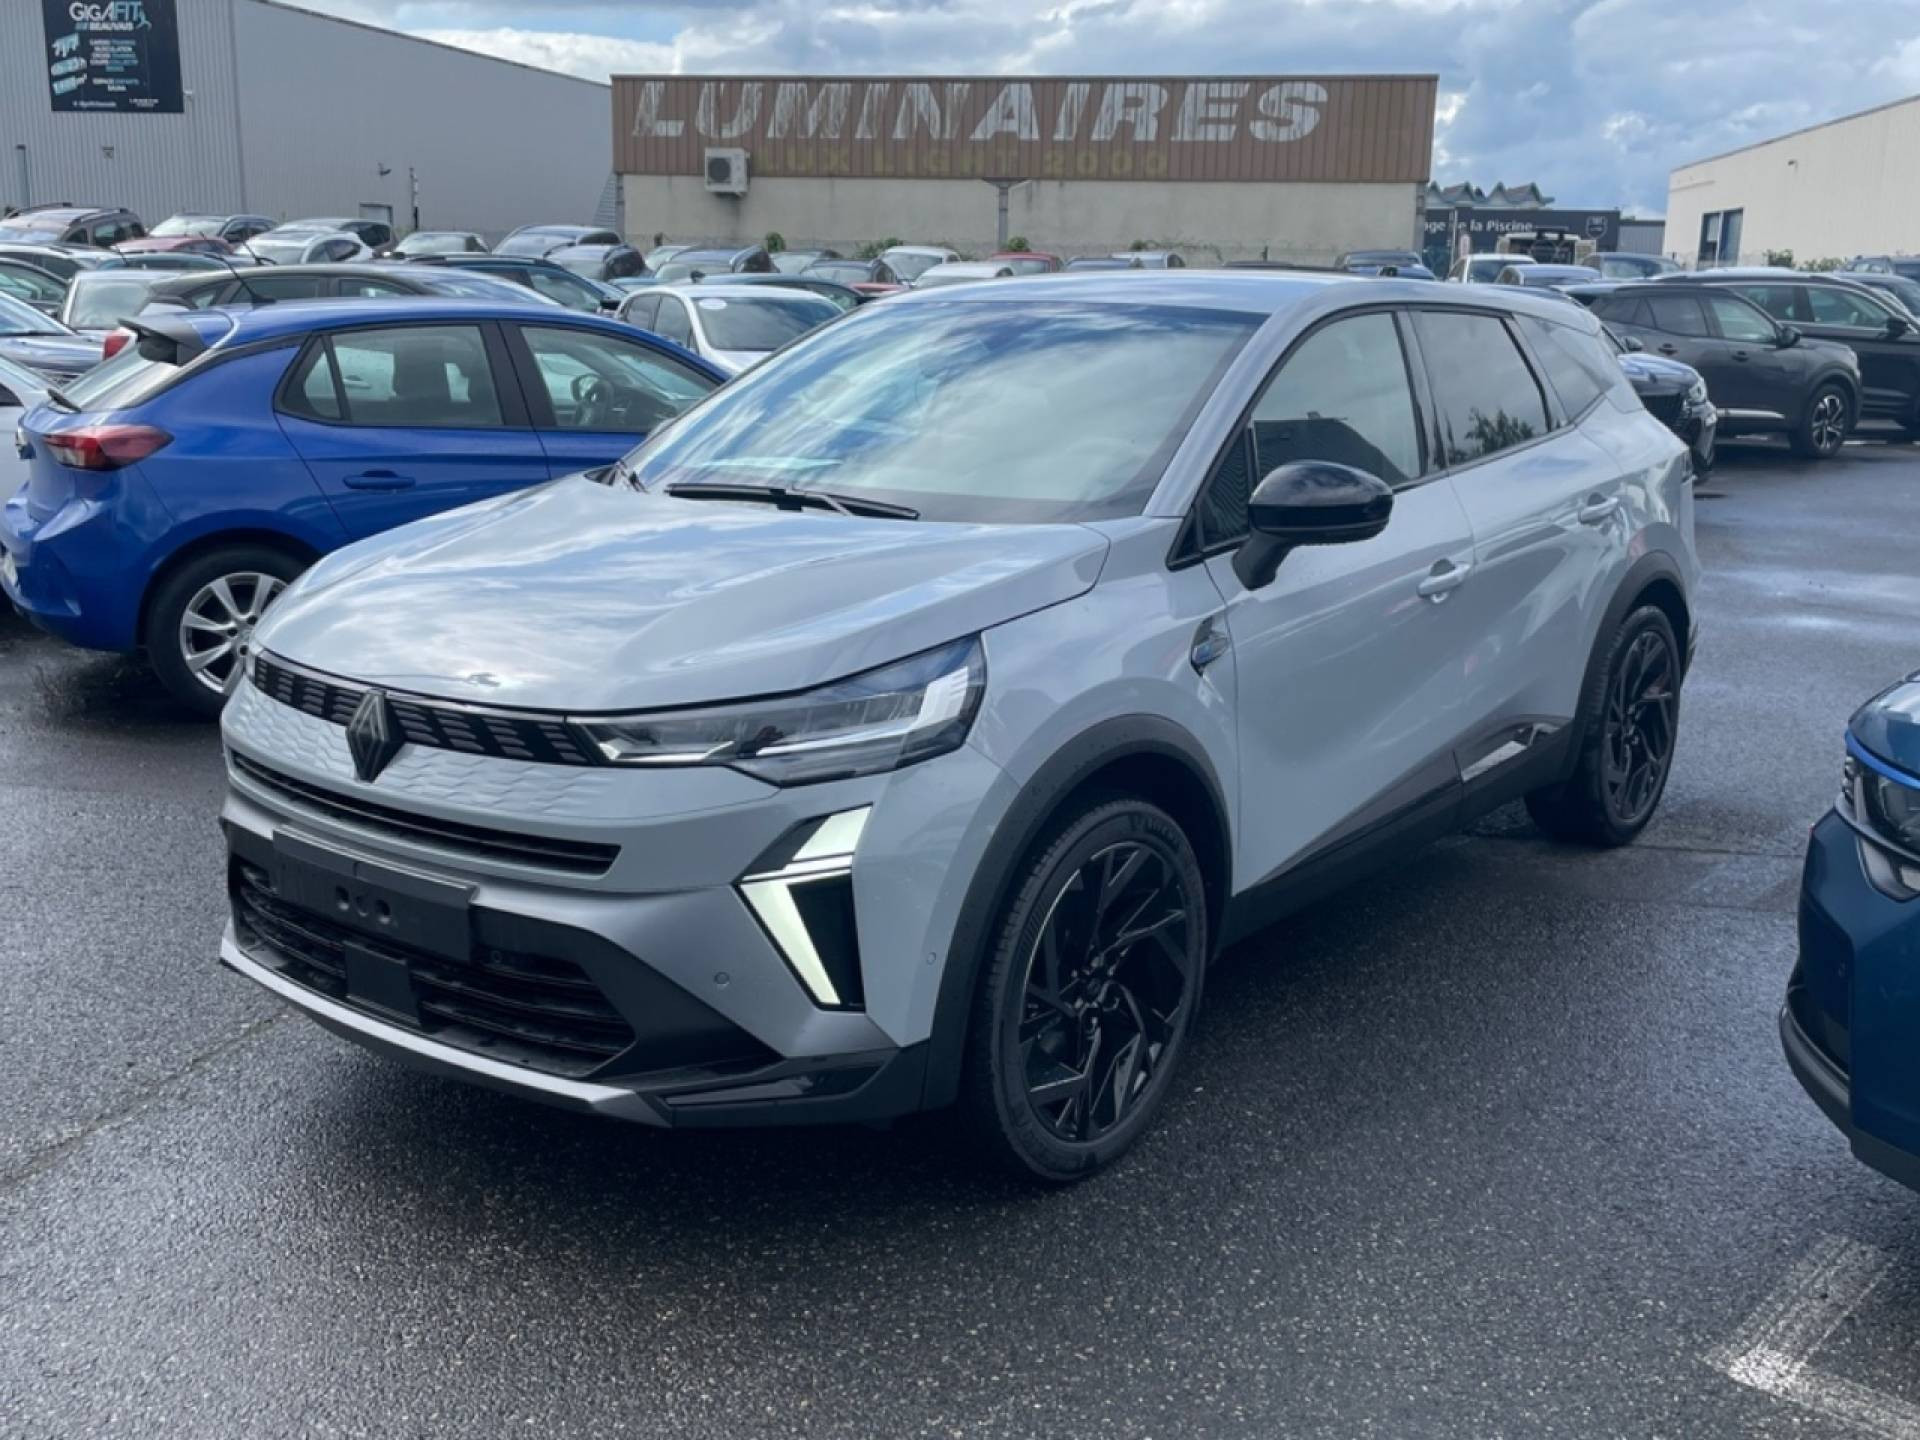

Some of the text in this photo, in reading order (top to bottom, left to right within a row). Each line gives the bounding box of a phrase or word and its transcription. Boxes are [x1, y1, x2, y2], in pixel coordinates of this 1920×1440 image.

[632, 81, 1328, 142] LUMINAIRES
[1043, 149, 1168, 175] 2000
[1486, 219, 1533, 232] Piscine
